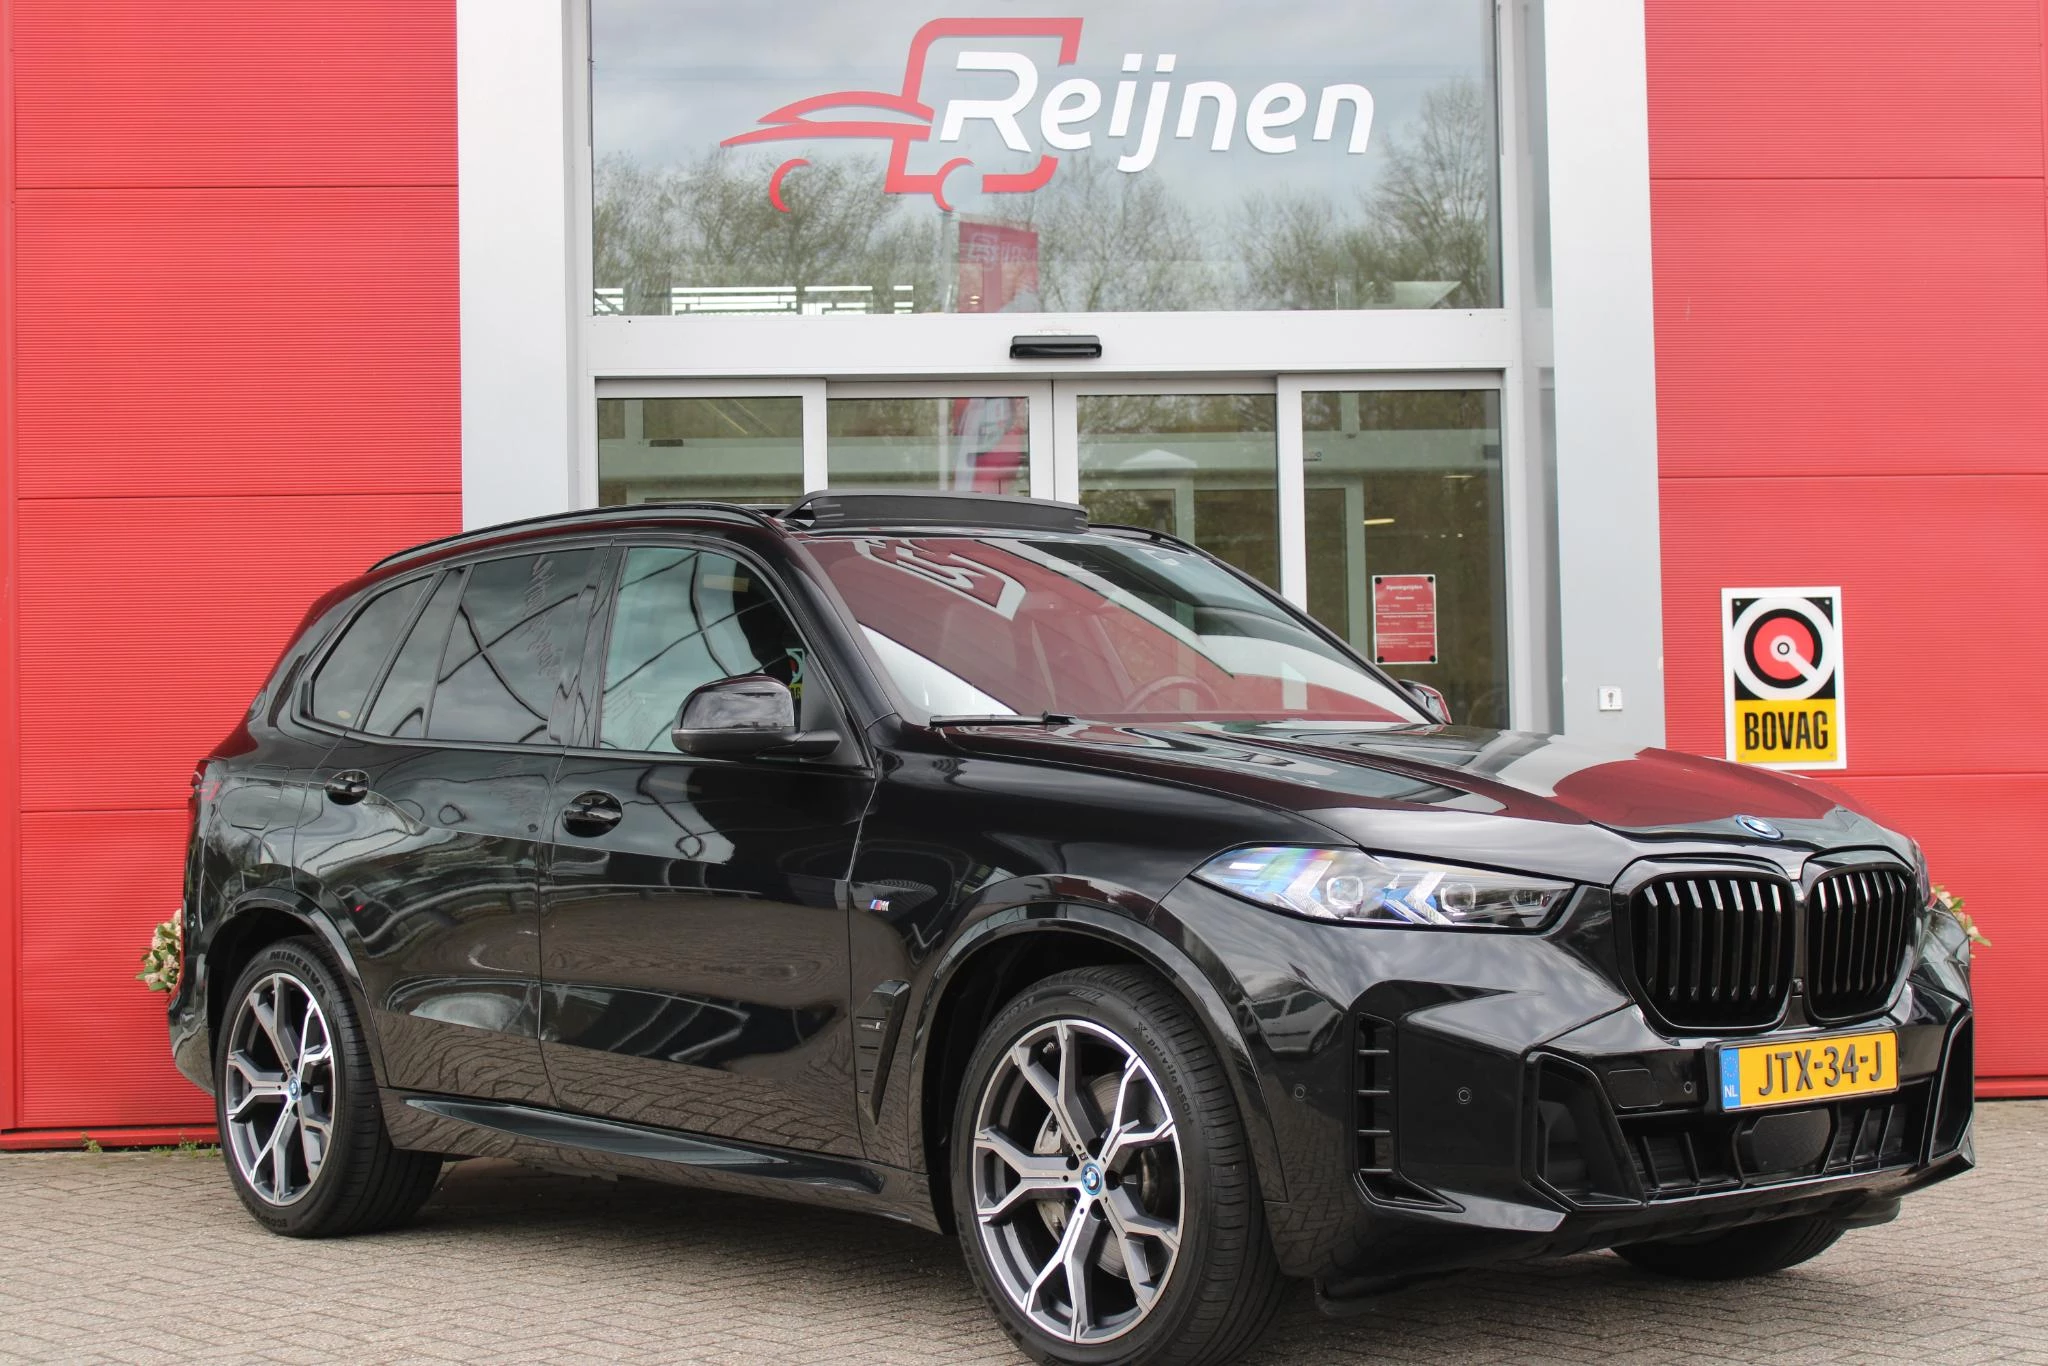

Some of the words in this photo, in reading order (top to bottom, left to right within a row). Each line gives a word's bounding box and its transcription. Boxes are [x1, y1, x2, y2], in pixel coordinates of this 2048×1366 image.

[940, 51, 1375, 173] Reijnen
[1744, 711, 1829, 751] BOVAG
[269, 950, 327, 999] MINERVA
[1724, 1085, 1738, 1098] NL
[1759, 1041, 1883, 1096] JTX-34-J
